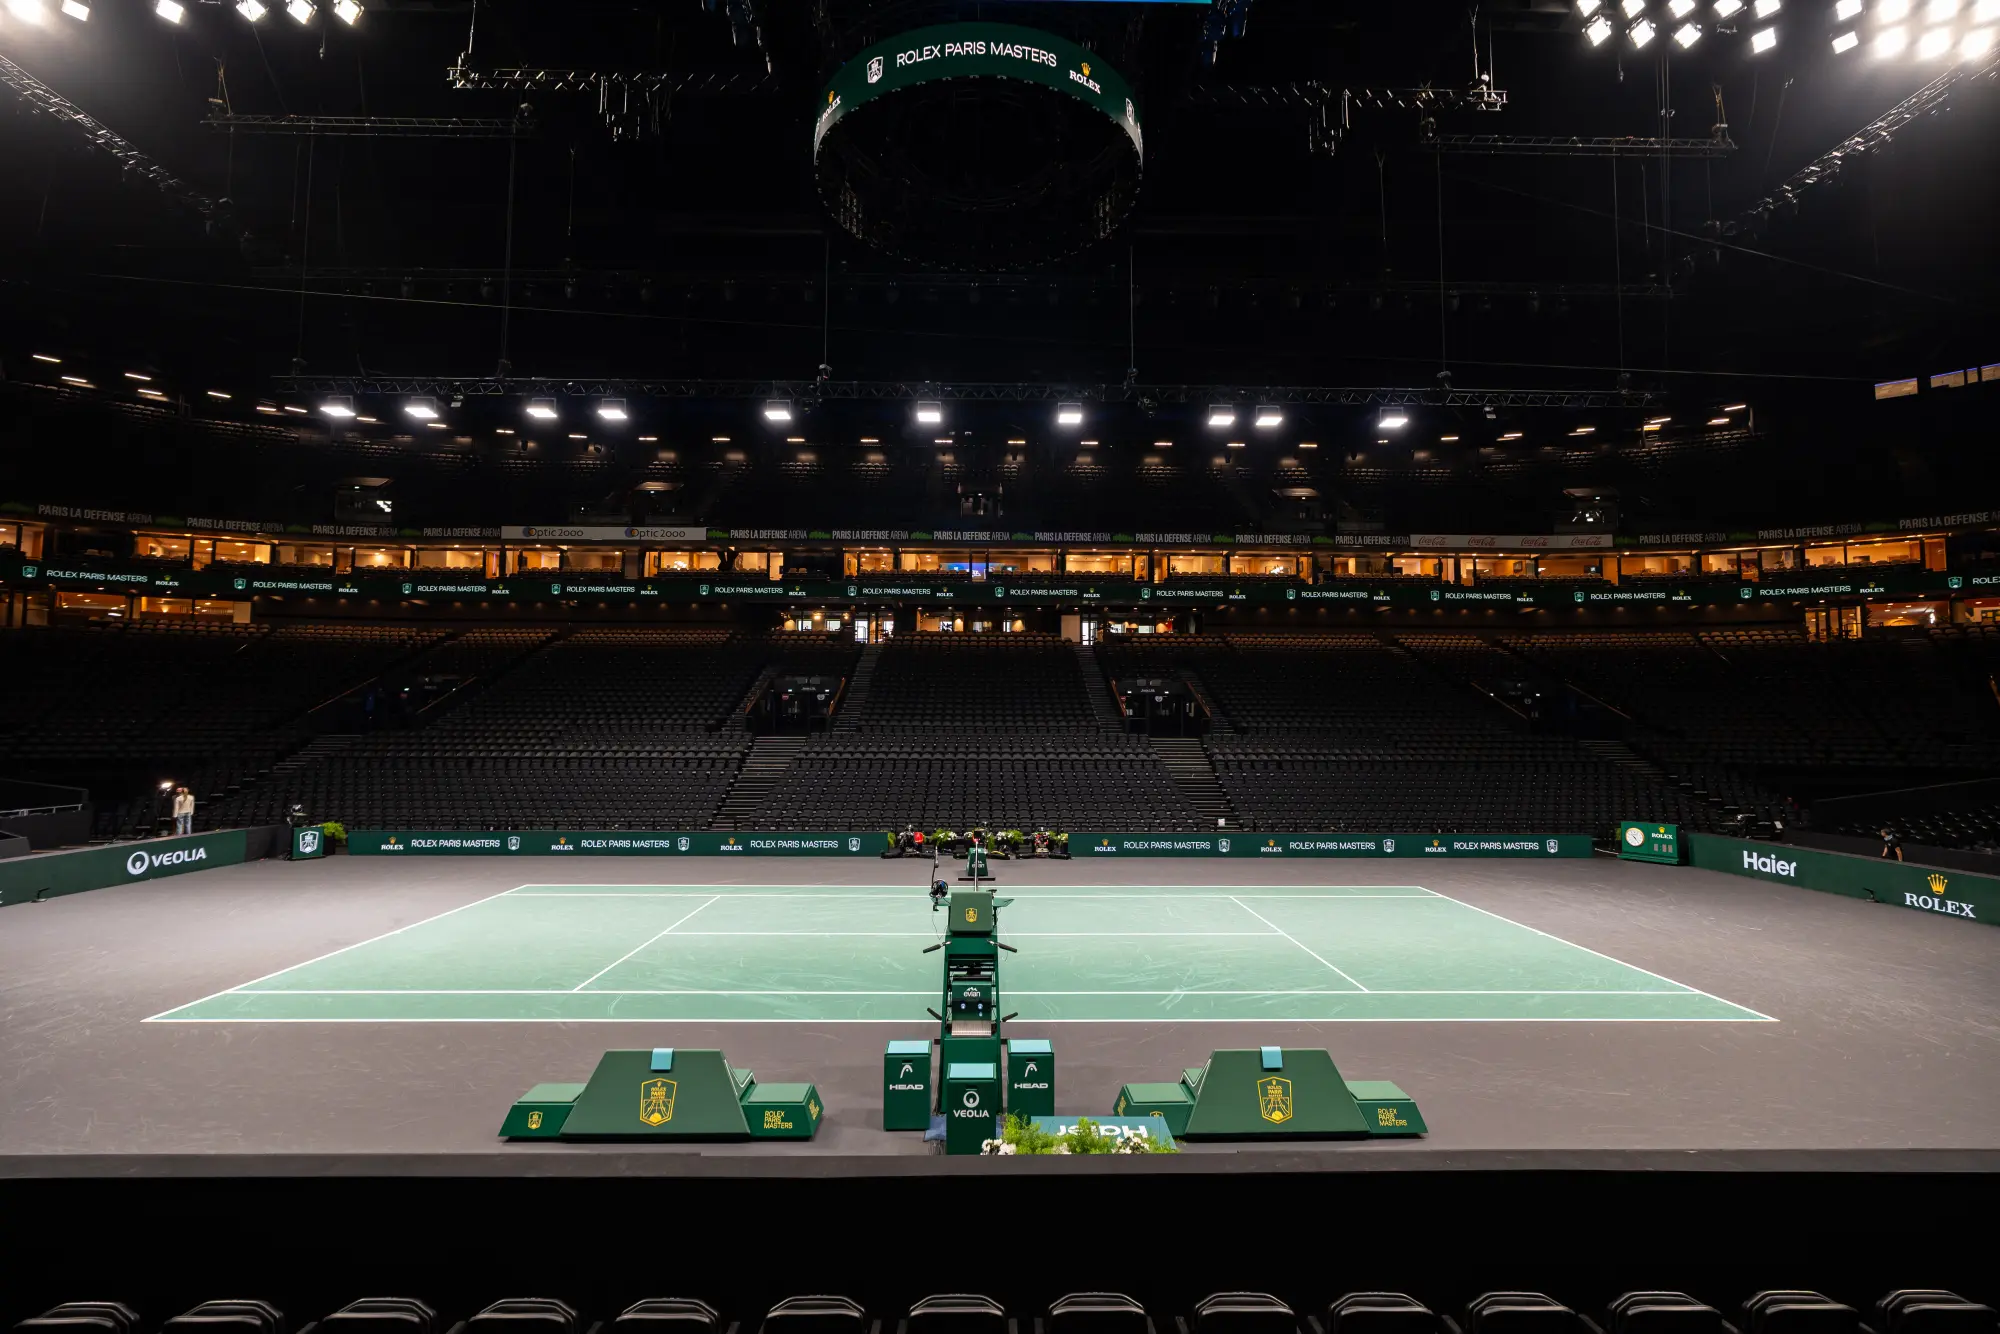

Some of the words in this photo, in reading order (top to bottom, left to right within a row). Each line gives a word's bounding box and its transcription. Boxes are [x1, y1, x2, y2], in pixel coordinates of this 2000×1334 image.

[897, 44, 941, 68] ROLEX
[945, 42, 986, 57] PARIS
[991, 42, 1057, 67] MASTERS
[1069, 69, 1101, 94] ROLEX
[38, 505, 68, 517] PARIS
[70, 507, 83, 518] LA
[84, 508, 125, 522] DEFENSE
[127, 511, 152, 524] ARENA
[187, 518, 212, 528] PARIS
[214, 519, 224, 529] LA
[226, 520, 260, 531] DEFENSE
[262, 522, 284, 532] ARENA
[1899, 517, 1927, 529] PARIS
[1930, 516, 1942, 527] LA
[1944, 512, 1989, 526] DEFENSE
[313, 525, 334, 535] PARIS
[336, 526, 345, 535] LA
[346, 526, 377, 536] DEFENSE
[378, 527, 397, 536] ARENA
[424, 528, 442, 537] PARIS
[443, 528, 452, 537] LA
[453, 528, 481, 537] DEFENSE
[482, 529, 500, 537] ARENA
[529, 528, 556, 539] Optic
[558, 529, 584, 537] 2000
[631, 529, 658, 539] Optic
[659, 529, 685, 538] 2000
[730, 529, 748, 539] PARIS
[750, 530, 759, 539] LA
[760, 530, 787, 539] DEFENSE
[788, 530, 807, 539] ARENA
[833, 531, 851, 539] PARIS
[852, 531, 860, 540] LA
[861, 531, 889, 540] DEFENSE
[890, 531, 908, 540] ARENA
[934, 531, 953, 540] PARIS
[954, 531, 961, 540] LA
[963, 531, 990, 540] DEFENSE
[992, 532, 1010, 540] ARENA
[1759, 529, 1782, 540] PARIS
[1784, 528, 1794, 538] LA
[1796, 525, 1834, 537] DEFENSE
[1836, 523, 1861, 534] ARENA
[1035, 532, 1053, 541] PARIS
[1054, 532, 1063, 541] LA
[1064, 532, 1091, 541] DEFENSE
[1093, 532, 1110, 541] ARENA
[1136, 533, 1154, 542] PARIS
[1155, 534, 1163, 542] LA
[1164, 534, 1192, 543] DEFENSE
[1193, 534, 1211, 543] ARENA
[1235, 534, 1254, 543] PARIS
[1255, 535, 1263, 543] LA
[1264, 535, 1291, 543] DEFENSE
[1293, 535, 1311, 544] ARENA
[1335, 536, 1353, 545] PARIS
[1354, 536, 1362, 545] LA
[1363, 536, 1390, 545] DEFENSE
[1392, 536, 1410, 545] ARENA
[1640, 534, 1661, 544] PARIS
[1662, 534, 1671, 543] LA
[1672, 533, 1703, 543] DEFENSE
[1704, 533, 1726, 542] ARENA
[47, 570, 77, 579] ROLEX
[79, 572, 105, 580] PARIS
[107, 573, 147, 582] MASTERS
[1760, 588, 1785, 596] ROLEX
[1787, 587, 1809, 595] PARIS
[1811, 586, 1851, 594] MASTERS
[411, 840, 437, 848] ROLEX
[439, 840, 461, 848] PARIS
[463, 840, 500, 848] MASTERS
[581, 840, 606, 848] ROLEX
[609, 840, 630, 848] PARIS
[632, 840, 669, 848] MASTERS
[750, 840, 776, 848] ROLEX
[777, 840, 799, 848] PARIS
[802, 840, 838, 848] MASTERS
[1290, 842, 1315, 850] ROLEX
[1317, 842, 1337, 850] PARIS
[1339, 842, 1375, 850] MASTERS
[1454, 842, 1479, 850] ROLEX
[1481, 842, 1501, 850] PARIS
[1503, 842, 1539, 850] MASTERS
[151, 847, 207, 867] VEOLIA
[1743, 851, 1797, 877] Haier
[1905, 892, 1976, 918] ROLEX
[953, 1110, 989, 1118] VEOLIA
